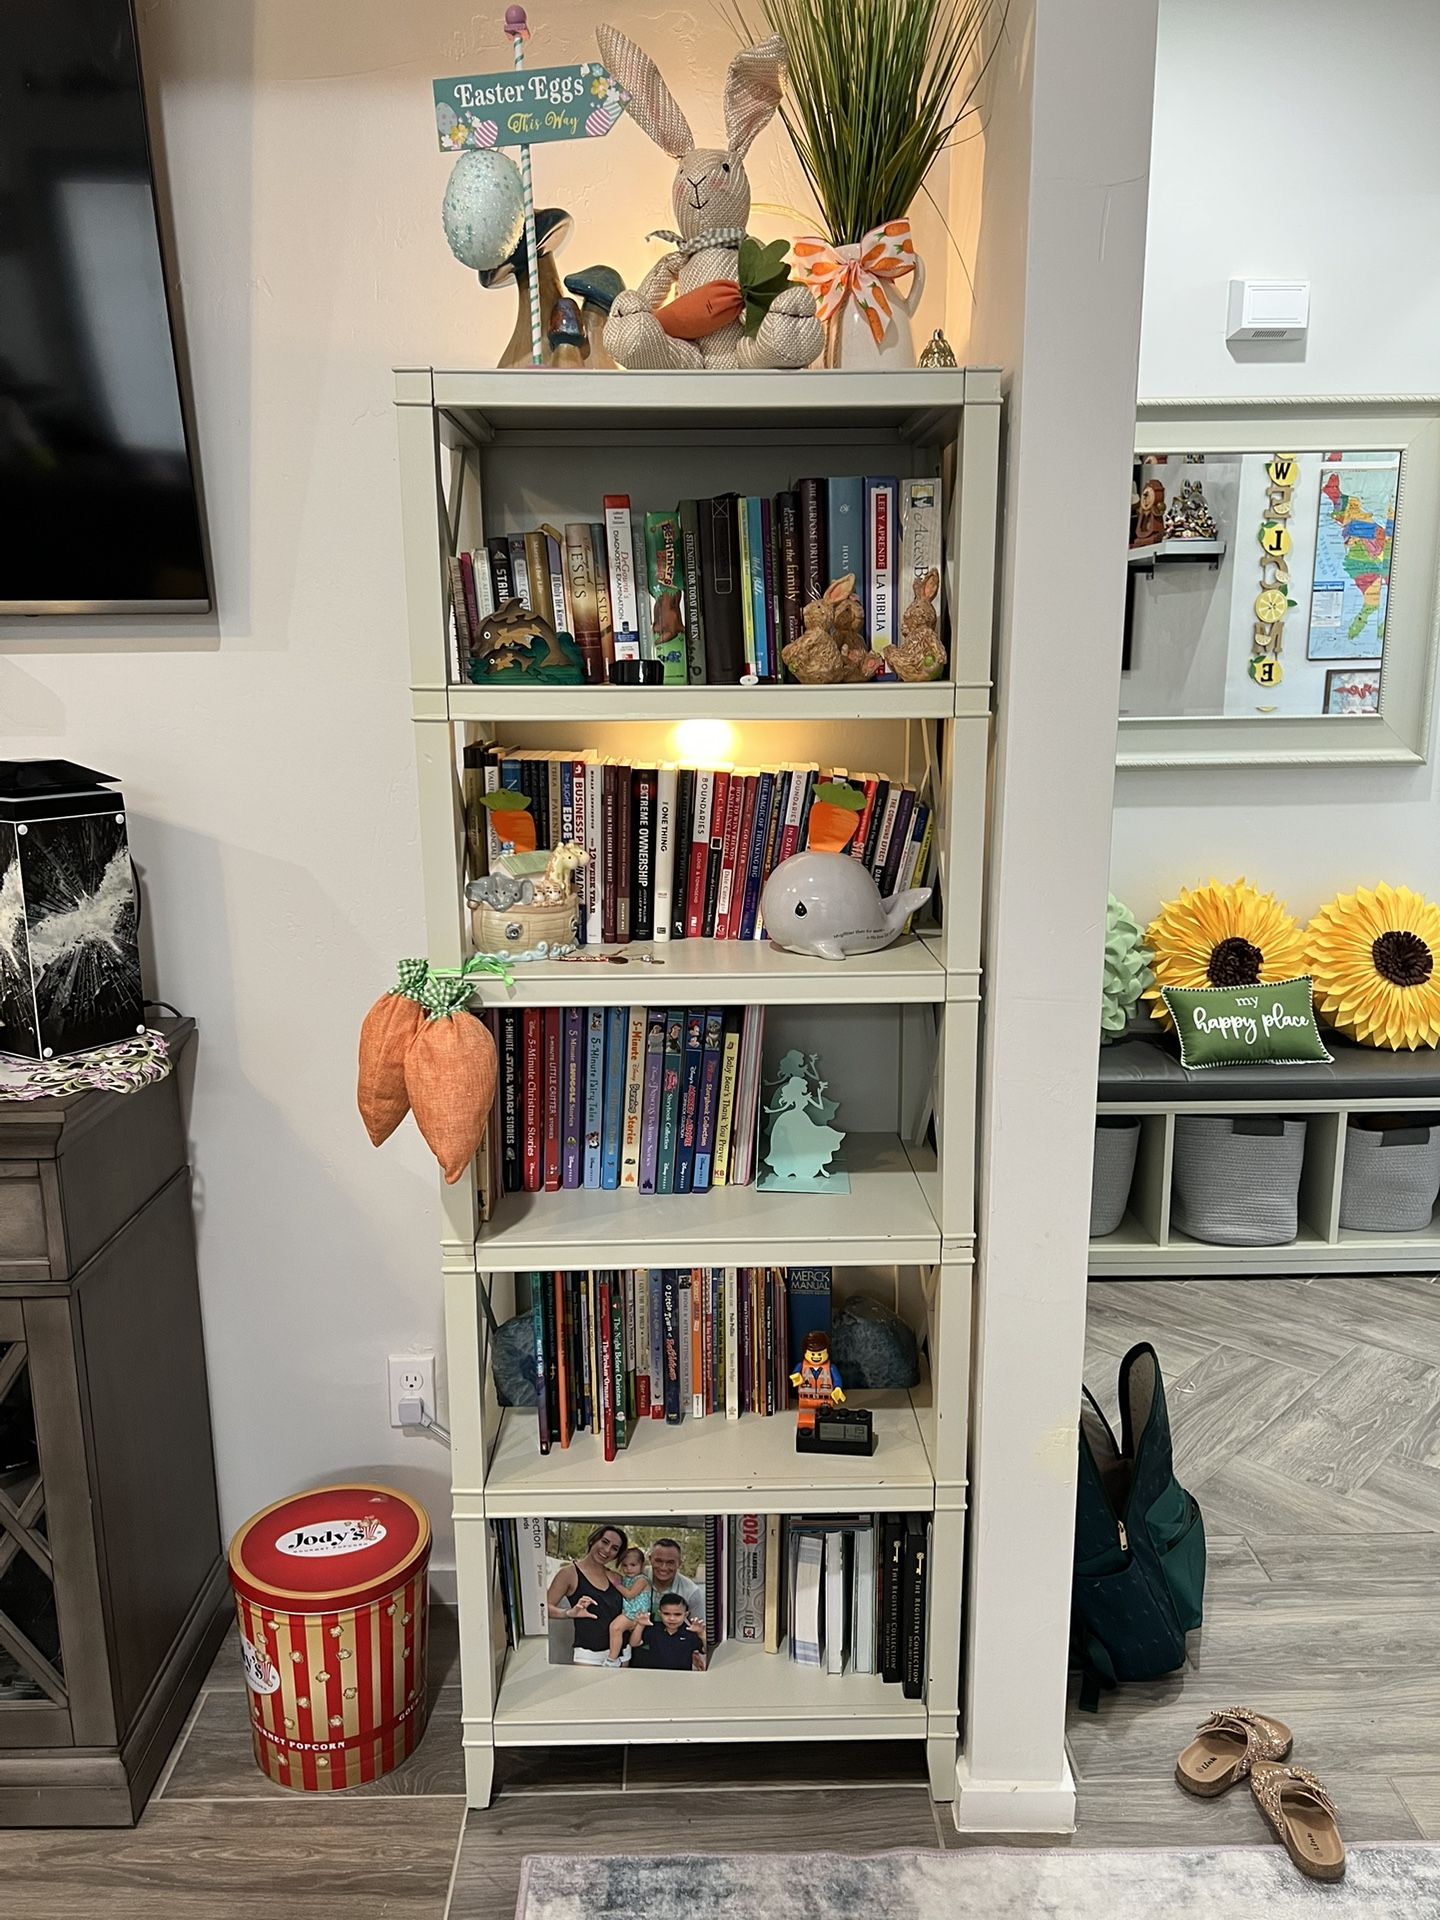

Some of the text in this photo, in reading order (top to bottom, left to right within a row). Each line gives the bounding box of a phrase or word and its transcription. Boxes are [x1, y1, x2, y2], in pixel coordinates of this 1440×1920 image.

[453, 75, 585, 108] Easter Eggs
[507, 109, 580, 135] This Way
[877, 495, 885, 512] LEE
[809, 501, 819, 540] PURPOSE
[613, 530, 623, 572] DIAGNOSTIC
[686, 534, 698, 569] STRENGTH
[810, 543, 819, 579] DRIVEN
[567, 544, 586, 599] JESUS
[621, 552, 631, 599] DeGowin's
[688, 571, 697, 585] FOR
[784, 539, 799, 601] in the family
[876, 574, 886, 589] LA
[552, 583, 564, 608] Only He
[596, 583, 608, 622] JESUS
[616, 574, 625, 620] EXAMINATION
[688, 585, 698, 607] TODAY
[689, 608, 698, 623] FOR
[877, 593, 887, 632] BIBLIA
[734, 786, 742, 801] HOW
[761, 779, 769, 795] THE
[575, 782, 584, 833] BUSINESS
[698, 777, 709, 835] BOUNDARIES
[725, 792, 734, 833] INFLUENCE
[733, 802, 740, 815] TO
[759, 795, 768, 816] MAGIC
[787, 775, 803, 835] BOUNDARIES IN
[563, 807, 573, 839] EDGE
[638, 784, 649, 886] EXTREME OWNERSHIP
[758, 817, 766, 827] OF
[883, 810, 895, 840] COMPOUND
[589, 847, 597, 860] 12
[729, 832, 737, 860] FRIENDS
[740, 829, 749, 864] GO-GIVER
[752, 830, 764, 865] THINKING
[878, 841, 889, 863] EFFECT
[721, 887, 729, 912] Carnegie
[1235, 997, 1259, 1008] my
[1193, 1003, 1310, 1044] happy place
[527, 1038, 536, 1079] 5-Minute
[590, 1038, 600, 1077] 5-Minute
[505, 1018, 515, 1144] 5-MINUTE STAR WARS STORIES
[548, 1062, 557, 1085] LITTLE
[627, 1021, 642, 1145] 5-Minute Disney Bunnies Stories
[688, 1066, 697, 1084] Disney's
[527, 1081, 536, 1125] Christmas
[548, 1086, 557, 1114] CRITTER
[588, 1079, 599, 1101] Fairy
[703, 1083, 712, 1116] Storybook
[568, 1104, 576, 1127] Stories
[589, 1103, 598, 1122] Tales
[664, 1093, 673, 1121] Storybook
[717, 1056, 734, 1163] Baby Bear's Thank You Prayer
[527, 1127, 536, 1157] Stories
[663, 1122, 672, 1150] Collection
[701, 1117, 710, 1147] Collection
[680, 1161, 688, 1175] Disney
[791, 1271, 830, 1281] MERCK
[791, 1281, 830, 1290] MANUAL
[664, 1291, 672, 1311] Little
[664, 1312, 673, 1331] Town
[613, 1317, 624, 1406] The Night Before Christmas
[288, 1528, 365, 1549] Jody's
[533, 1518, 543, 1548] ection
[742, 1514, 758, 1545] 2014
[913, 1598, 921, 1634] REGISTRY
[289, 1741, 346, 1751] POPCORN
